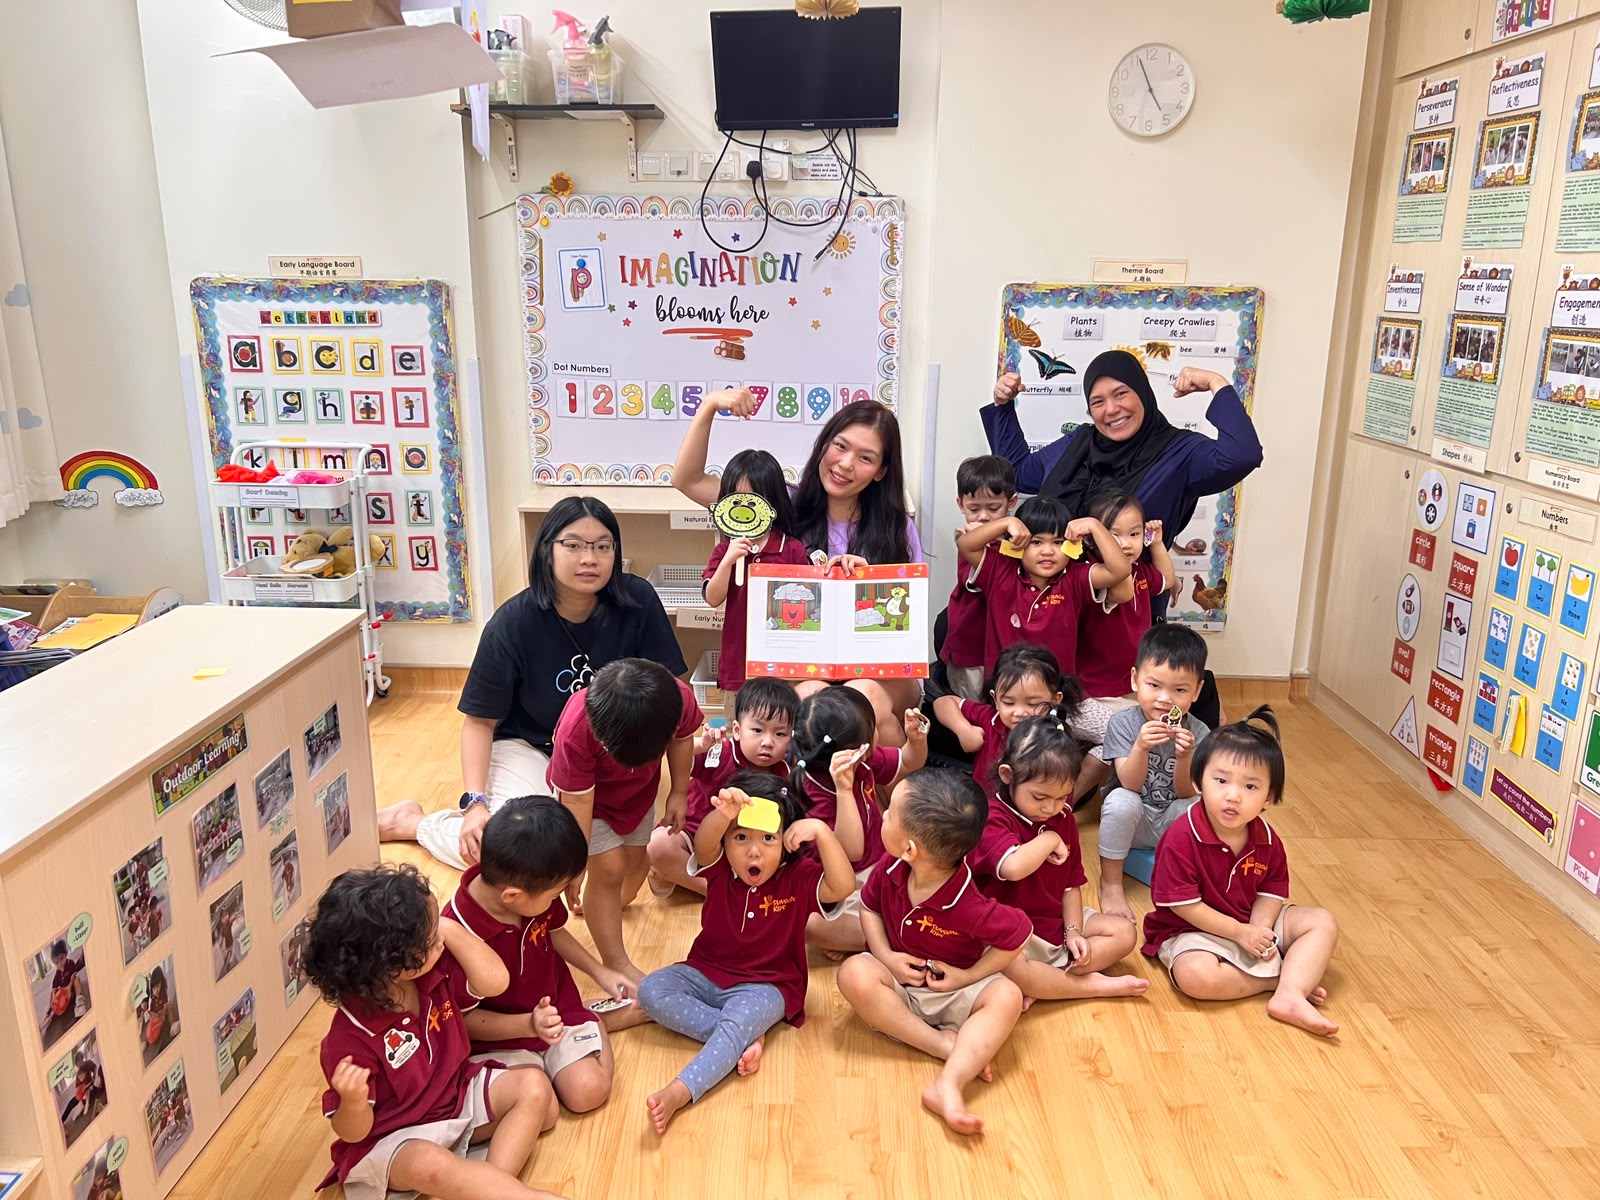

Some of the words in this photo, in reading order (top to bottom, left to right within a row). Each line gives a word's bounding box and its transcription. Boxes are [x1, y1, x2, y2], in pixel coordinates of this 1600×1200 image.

[1507, 0, 1549, 25] PRAISE
[1130, 55, 1140, 67] 11
[1146, 48, 1158, 61] 12
[1167, 51, 1171, 64] 1
[1117, 69, 1129, 80] 10
[1176, 64, 1184, 77] 2
[1111, 86, 1119, 98] 9
[1180, 82, 1189, 94] 3
[1491, 77, 1539, 96] Reflectiveness
[1116, 104, 1124, 116] 8
[1175, 100, 1184, 112] 4
[1418, 98, 1453, 113] Perseverance
[1129, 115, 1137, 128] 7
[1144, 120, 1153, 132] 6
[1162, 113, 1171, 126] 5
[298, 261, 333, 269] Language
[619, 250, 802, 288] IMAGINATION
[1387, 284, 1421, 294] Inventiveness
[1459, 282, 1475, 292] Sense
[1476, 282, 1484, 292] of
[1485, 282, 1508, 293] Wonder
[655, 295, 725, 324] blooms
[730, 295, 769, 323] here
[1070, 316, 1097, 325] Plants
[1143, 317, 1175, 327] Creepy
[1178, 317, 1215, 326] Crawlies
[1074, 329, 1092, 338] 植物
[1169, 329, 1187, 338] 爬虫
[233, 341, 258, 368] a
[275, 341, 298, 368] b
[359, 345, 376, 371] d
[399, 352, 416, 371] e
[553, 363, 568, 371] Dot
[571, 364, 609, 373] Numbers
[320, 393, 339, 417] h
[566, 383, 577, 413] 1
[593, 384, 614, 415] 2
[621, 384, 643, 416] 3
[651, 384, 675, 415] 4
[682, 386, 703, 416] 5
[749, 385, 769, 416] 7
[776, 386, 799, 418] 8
[807, 387, 831, 420] 9
[250, 450, 264, 469] k
[323, 452, 346, 469] m
[365, 449, 386, 469] n
[405, 448, 427, 469] o
[1442, 447, 1461, 461] Shapes
[1545, 469, 1568, 482] Numeracy
[1568, 474, 1581, 484] Board
[265, 489, 289, 497] Dancing
[371, 497, 388, 520] s
[1541, 509, 1569, 525] Numbers
[1415, 535, 1431, 549] circle
[415, 543, 431, 567] y
[1453, 560, 1475, 576] square
[694, 615, 711, 623] Early
[1567, 609, 1581, 620] three
[1398, 646, 1410, 659] oval
[1431, 678, 1460, 702] rectangle
[1433, 697, 1453, 717] 长方形
[1429, 731, 1453, 753] triangle
[163, 758, 205, 793] Outdoor
[203, 732, 240, 765] Learning
[1428, 751, 1448, 770] 三角形
[1508, 786, 1522, 800] count
[1522, 796, 1530, 807] the
[1573, 863, 1590, 883] Pink
